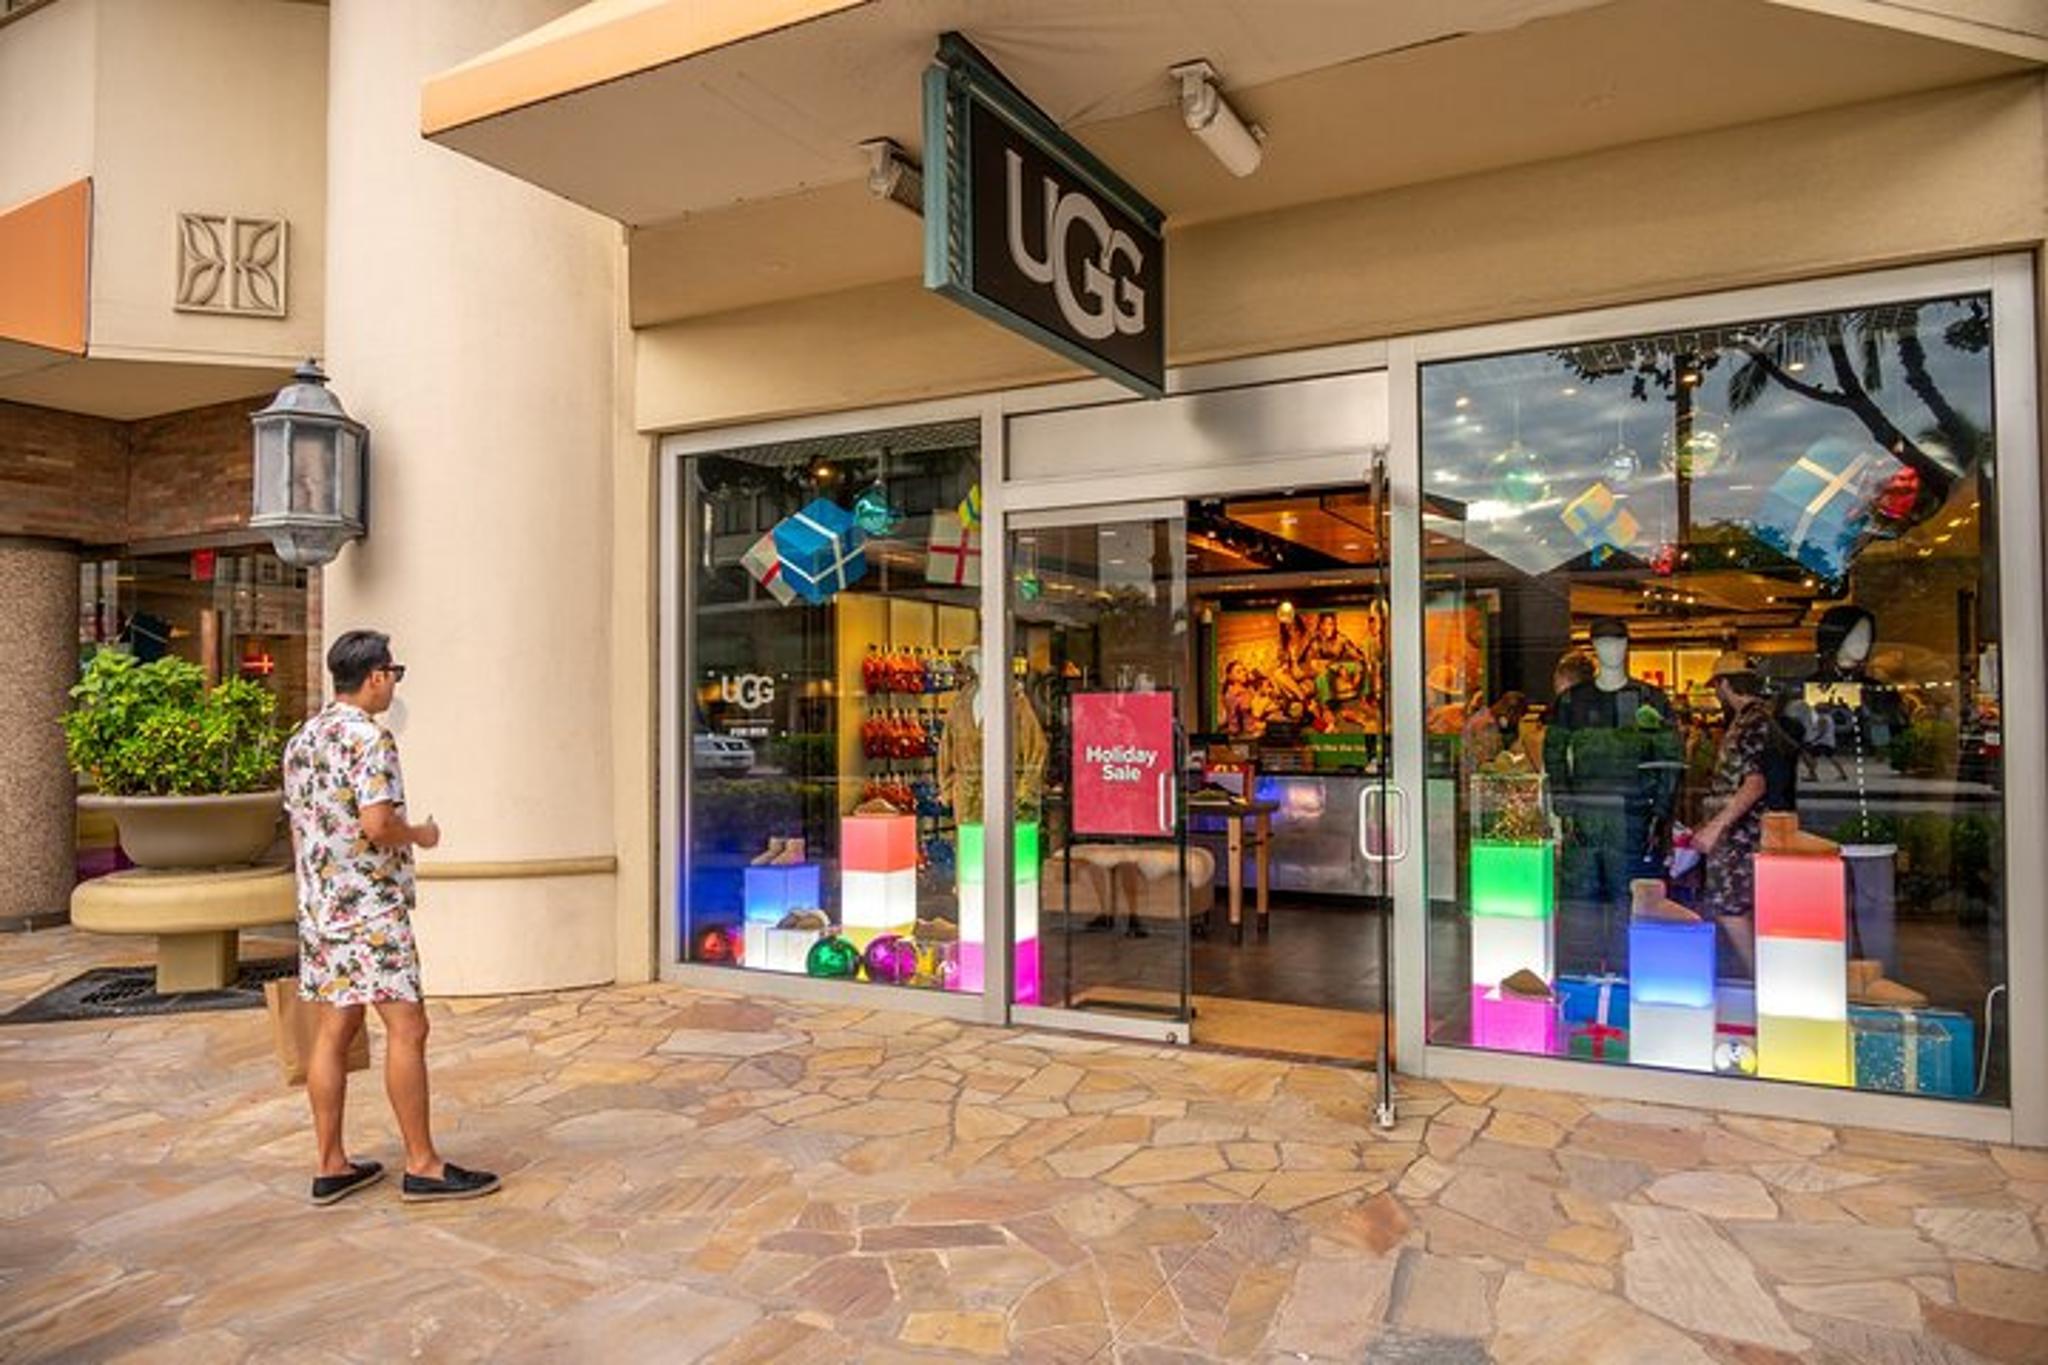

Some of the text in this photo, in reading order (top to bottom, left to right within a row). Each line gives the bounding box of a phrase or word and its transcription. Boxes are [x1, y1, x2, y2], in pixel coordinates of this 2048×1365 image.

[1006, 148, 1145, 340] UGG
[721, 673, 775, 710] UGG
[1085, 744, 1158, 768] Holiday
[1102, 764, 1141, 781] Sale
